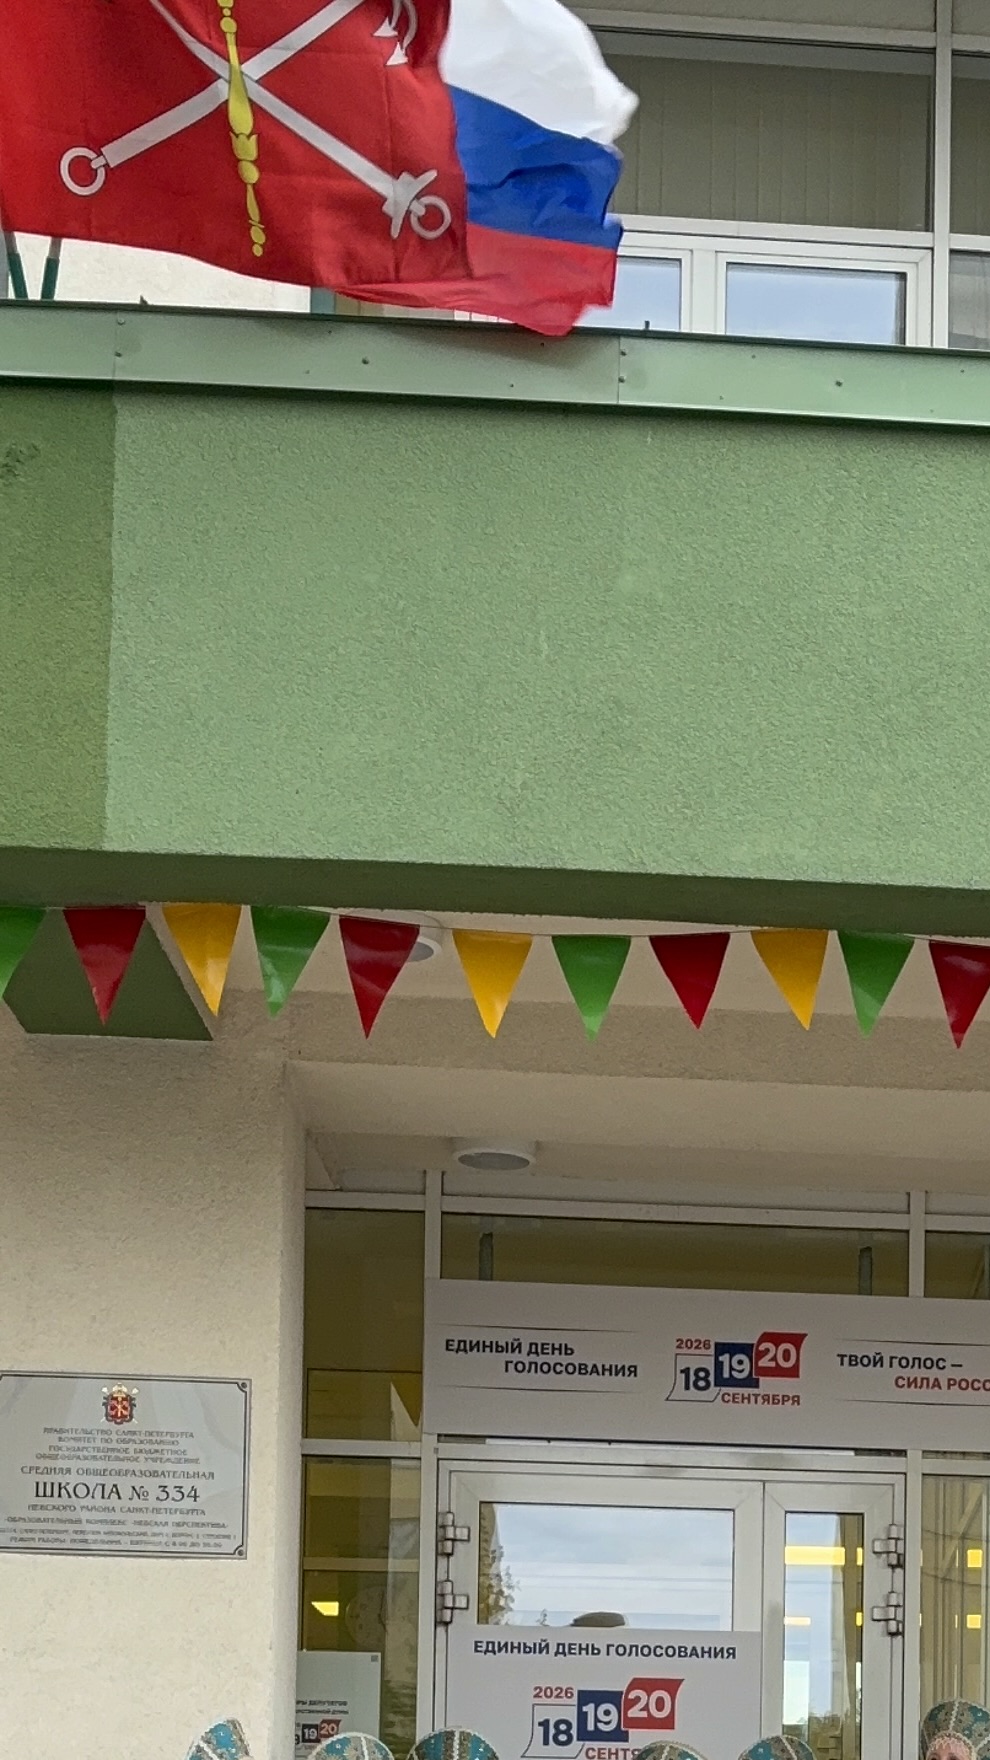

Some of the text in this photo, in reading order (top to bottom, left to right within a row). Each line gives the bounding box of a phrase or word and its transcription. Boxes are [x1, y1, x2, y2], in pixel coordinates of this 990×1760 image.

[445, 1338, 575, 1357] ЕДИНЫЙ ДЕНЬ
[676, 1338, 711, 1350] 2026
[758, 1342, 797, 1368] 20
[837, 1352, 884, 1368] ТВОЙ
[889, 1356, 947, 1370] ГОЛОС
[504, 1360, 638, 1377] ГОЛОСОВАНИЯ
[718, 1353, 750, 1379] 19
[680, 1366, 711, 1391] 18
[894, 1376, 942, 1390] СИЛА
[721, 1392, 800, 1406] СЕНТЯБРЯ
[20, 1466, 215, 1480] СРЕДНЯЯ ОБЩЕОБРАЗОВАТЕЛЬНАЯ
[34, 1481, 200, 1502] ШКОЛА № 334
[474, 1638, 736, 1659] ЕДИНЫЙ ДЕНЬ ГОЛОСОВАНИЯ
[533, 1686, 574, 1699] 2026
[627, 1690, 672, 1718] 20
[582, 1703, 619, 1731] 19
[320, 1723, 337, 1734] 20
[538, 1718, 573, 1746] 18
